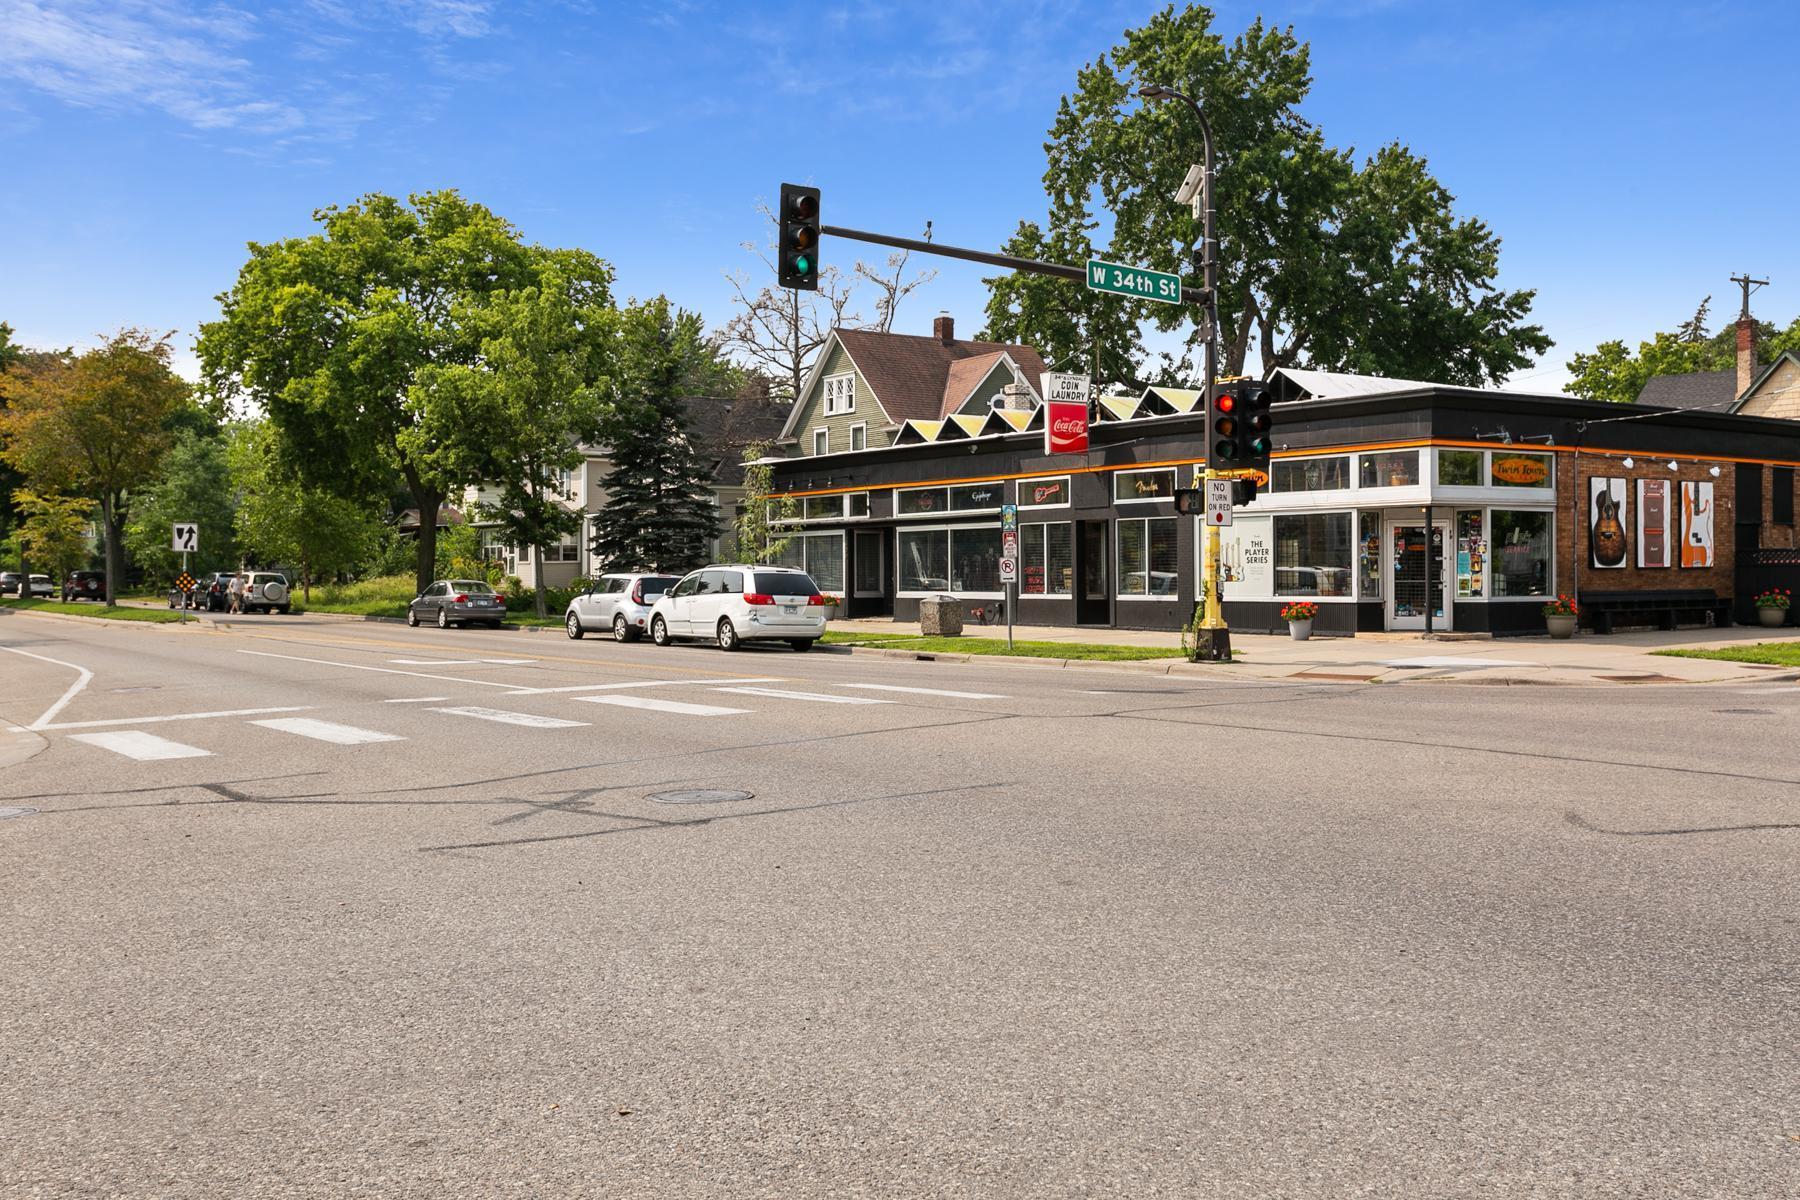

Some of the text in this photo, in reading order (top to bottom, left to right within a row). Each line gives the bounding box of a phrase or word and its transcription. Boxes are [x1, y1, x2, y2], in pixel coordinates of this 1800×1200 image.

[1093, 266, 1176, 297] W 34th St
[1061, 381, 1079, 390] COIN
[1051, 390, 1086, 400] LAUNDRY
[1498, 463, 1545, 476] Twin Town
[1213, 482, 1225, 492] NO
[1209, 503, 1217, 511] ON
[1251, 540, 1263, 548] THE
[1246, 556, 1268, 564] SERIES
